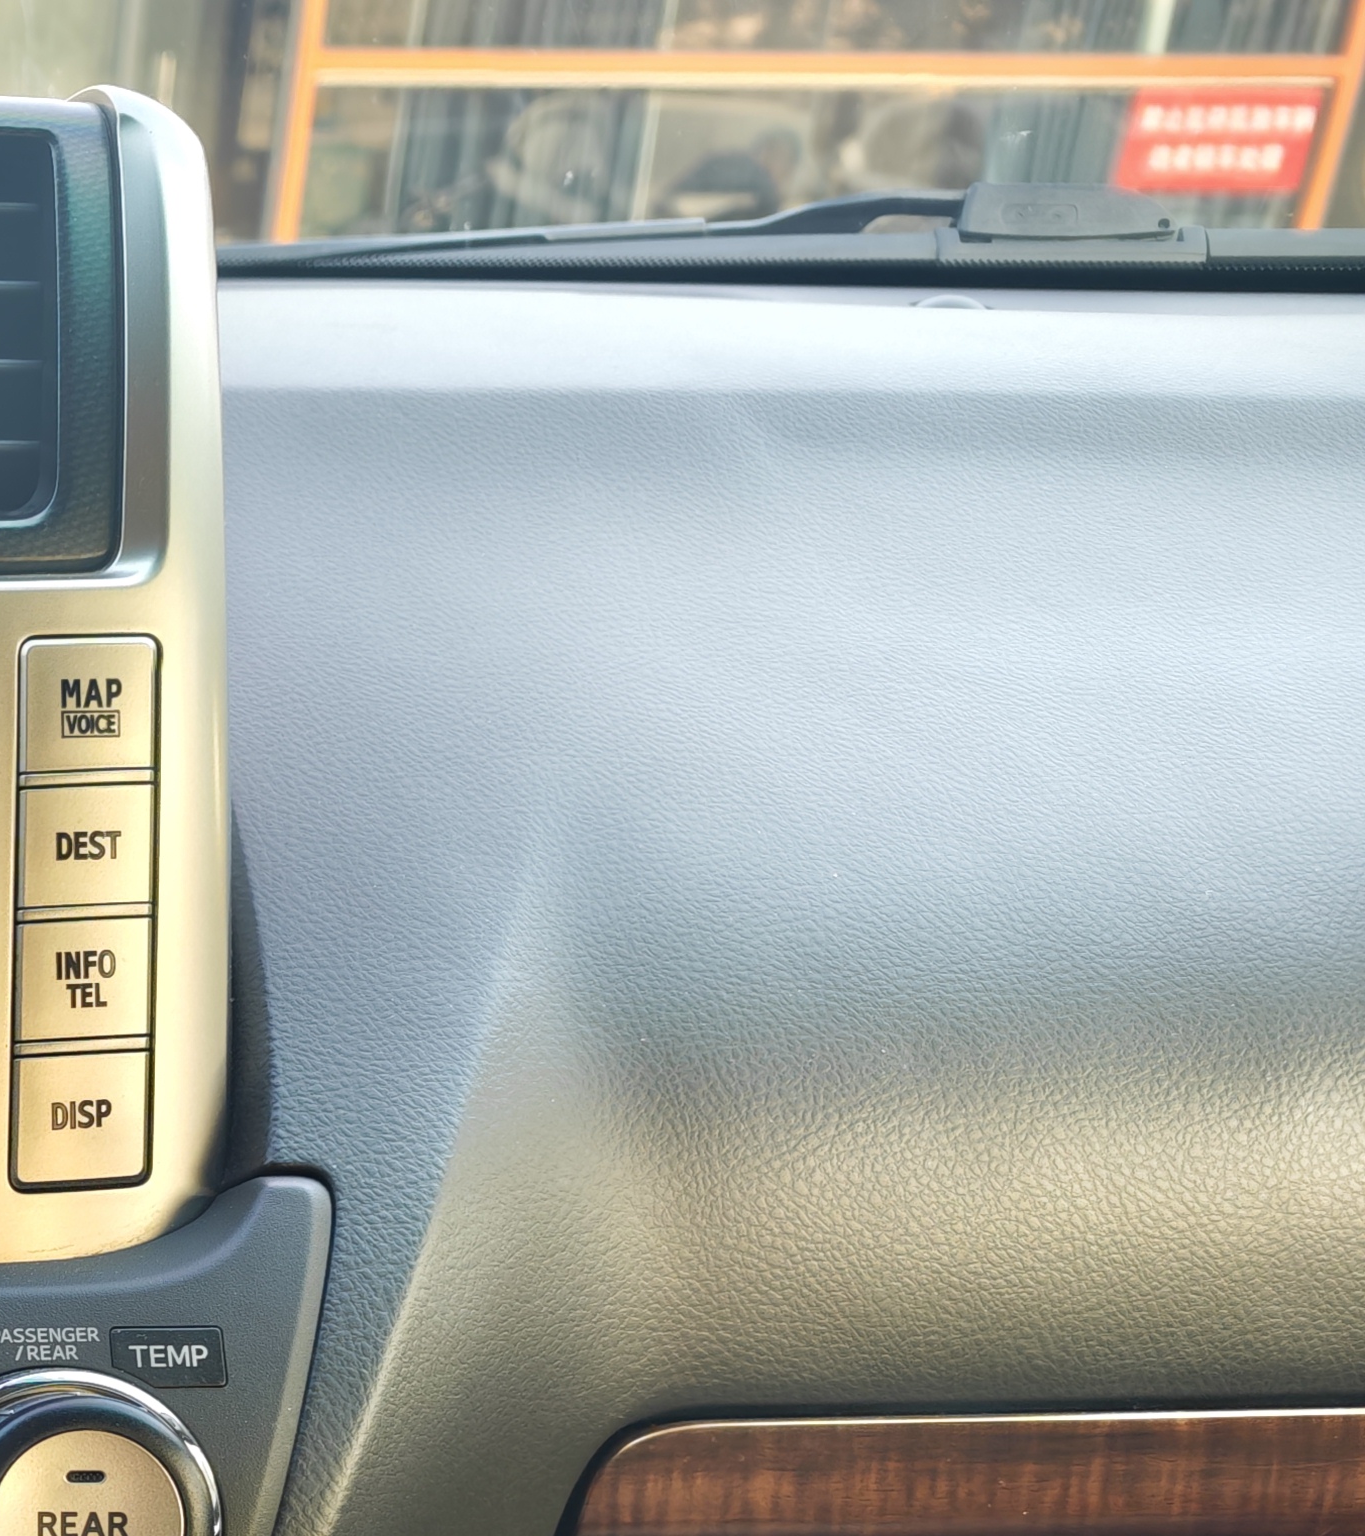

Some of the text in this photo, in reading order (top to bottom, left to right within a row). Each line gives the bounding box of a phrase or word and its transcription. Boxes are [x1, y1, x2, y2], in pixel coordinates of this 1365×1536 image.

[60, 678, 123, 709] MAP
[66, 715, 117, 735] VOICE
[55, 830, 122, 862] DEST
[55, 949, 116, 980] INFO
[65, 982, 108, 1009] TEL
[51, 1098, 113, 1131] DISP
[15, 1345, 79, 1361] /REAR
[127, 1344, 209, 1369] TEMP
